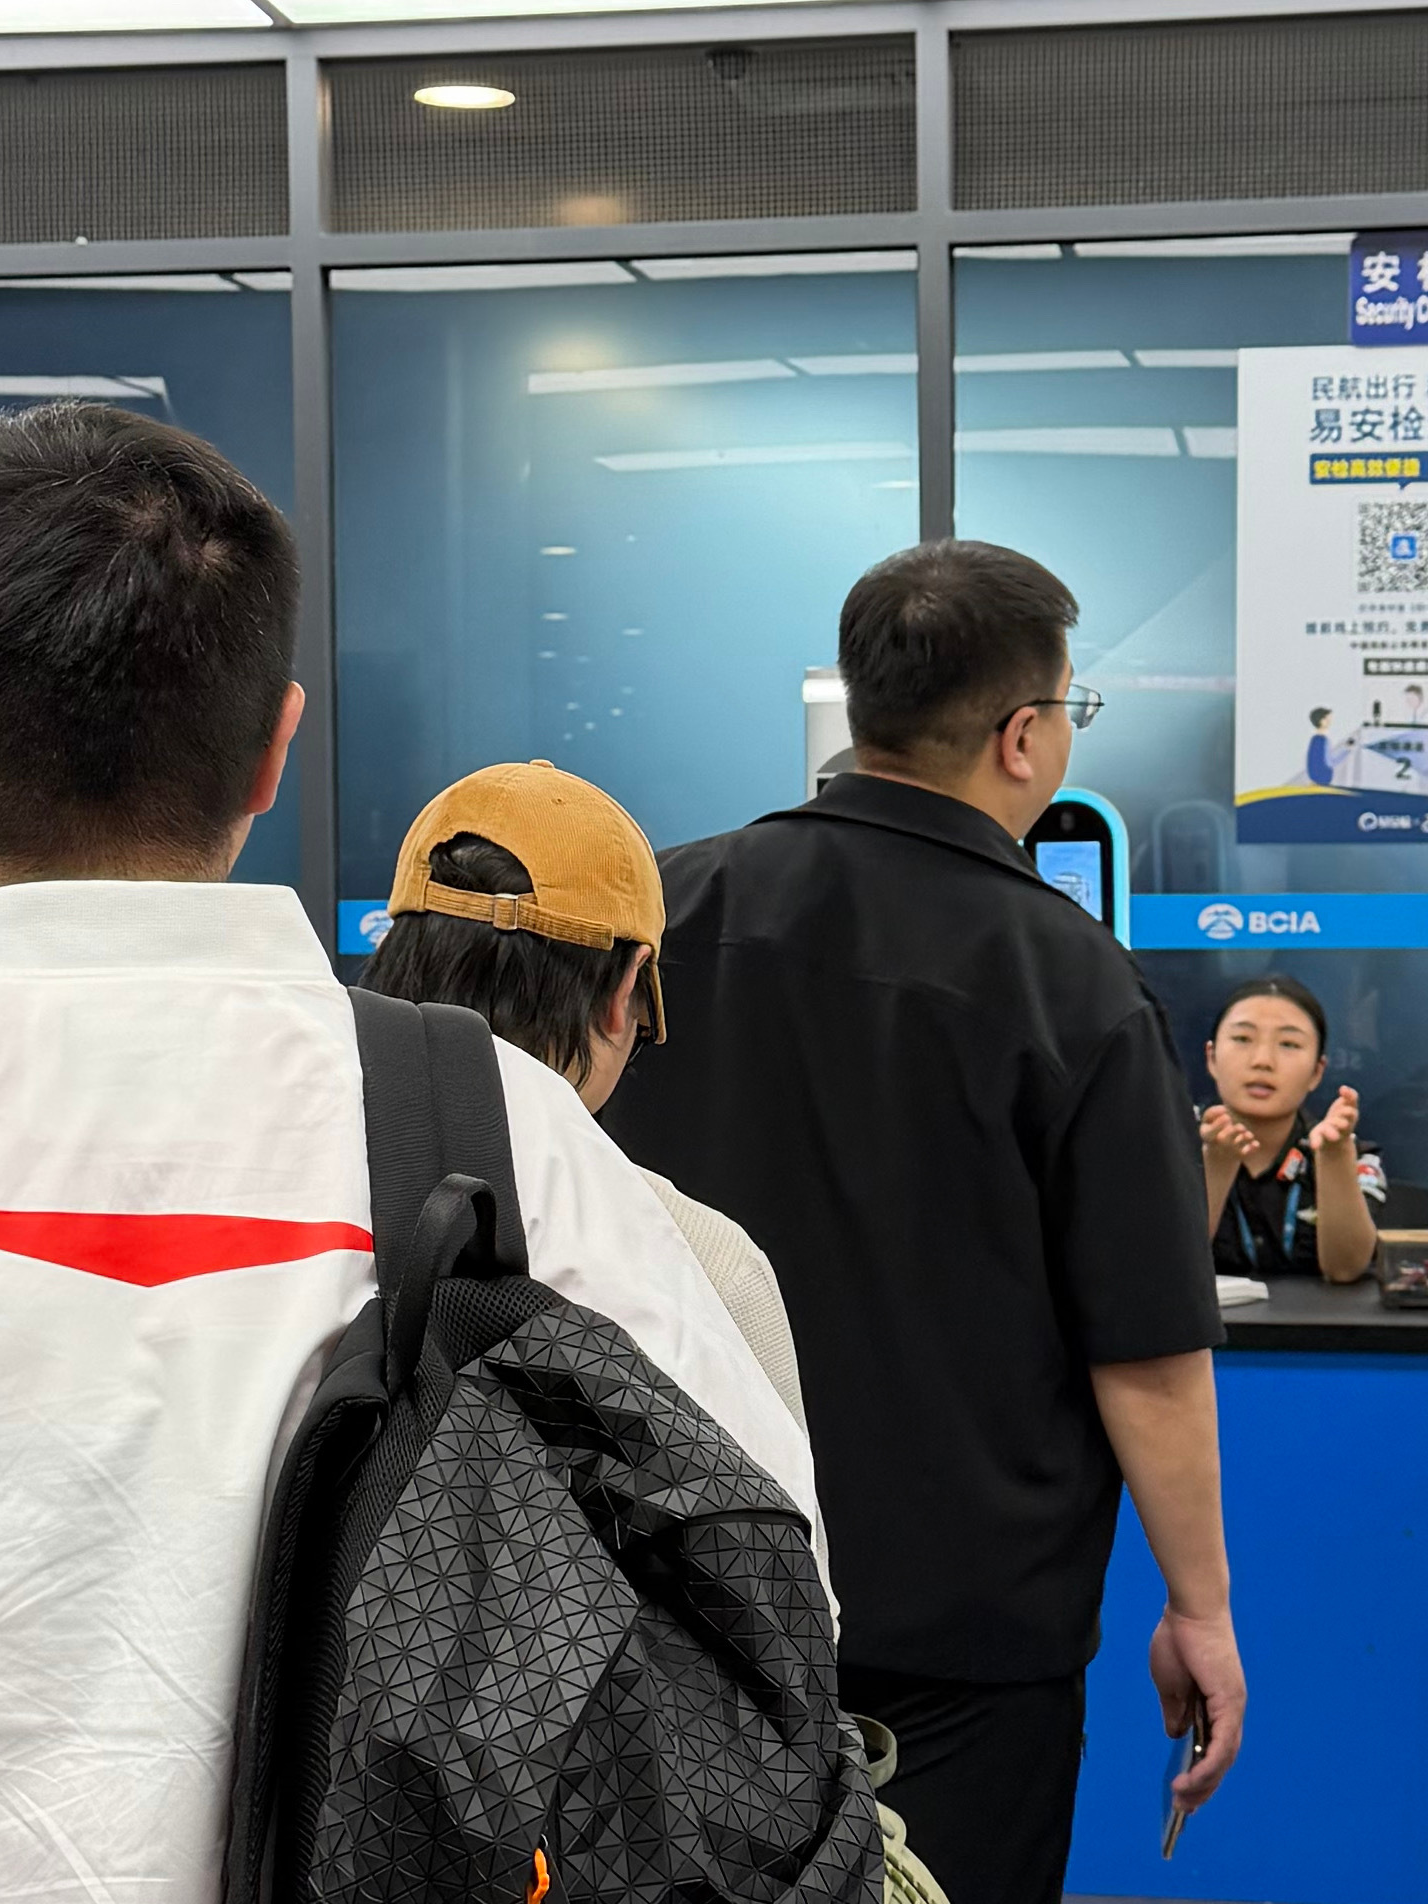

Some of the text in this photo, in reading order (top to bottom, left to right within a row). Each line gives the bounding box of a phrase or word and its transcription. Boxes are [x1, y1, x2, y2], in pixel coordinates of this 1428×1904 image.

[1355, 296, 1415, 330] Security
[1312, 373, 1416, 401] 民航出行
[1395, 757, 1411, 780] 2
[1248, 911, 1321, 934] BCIA
